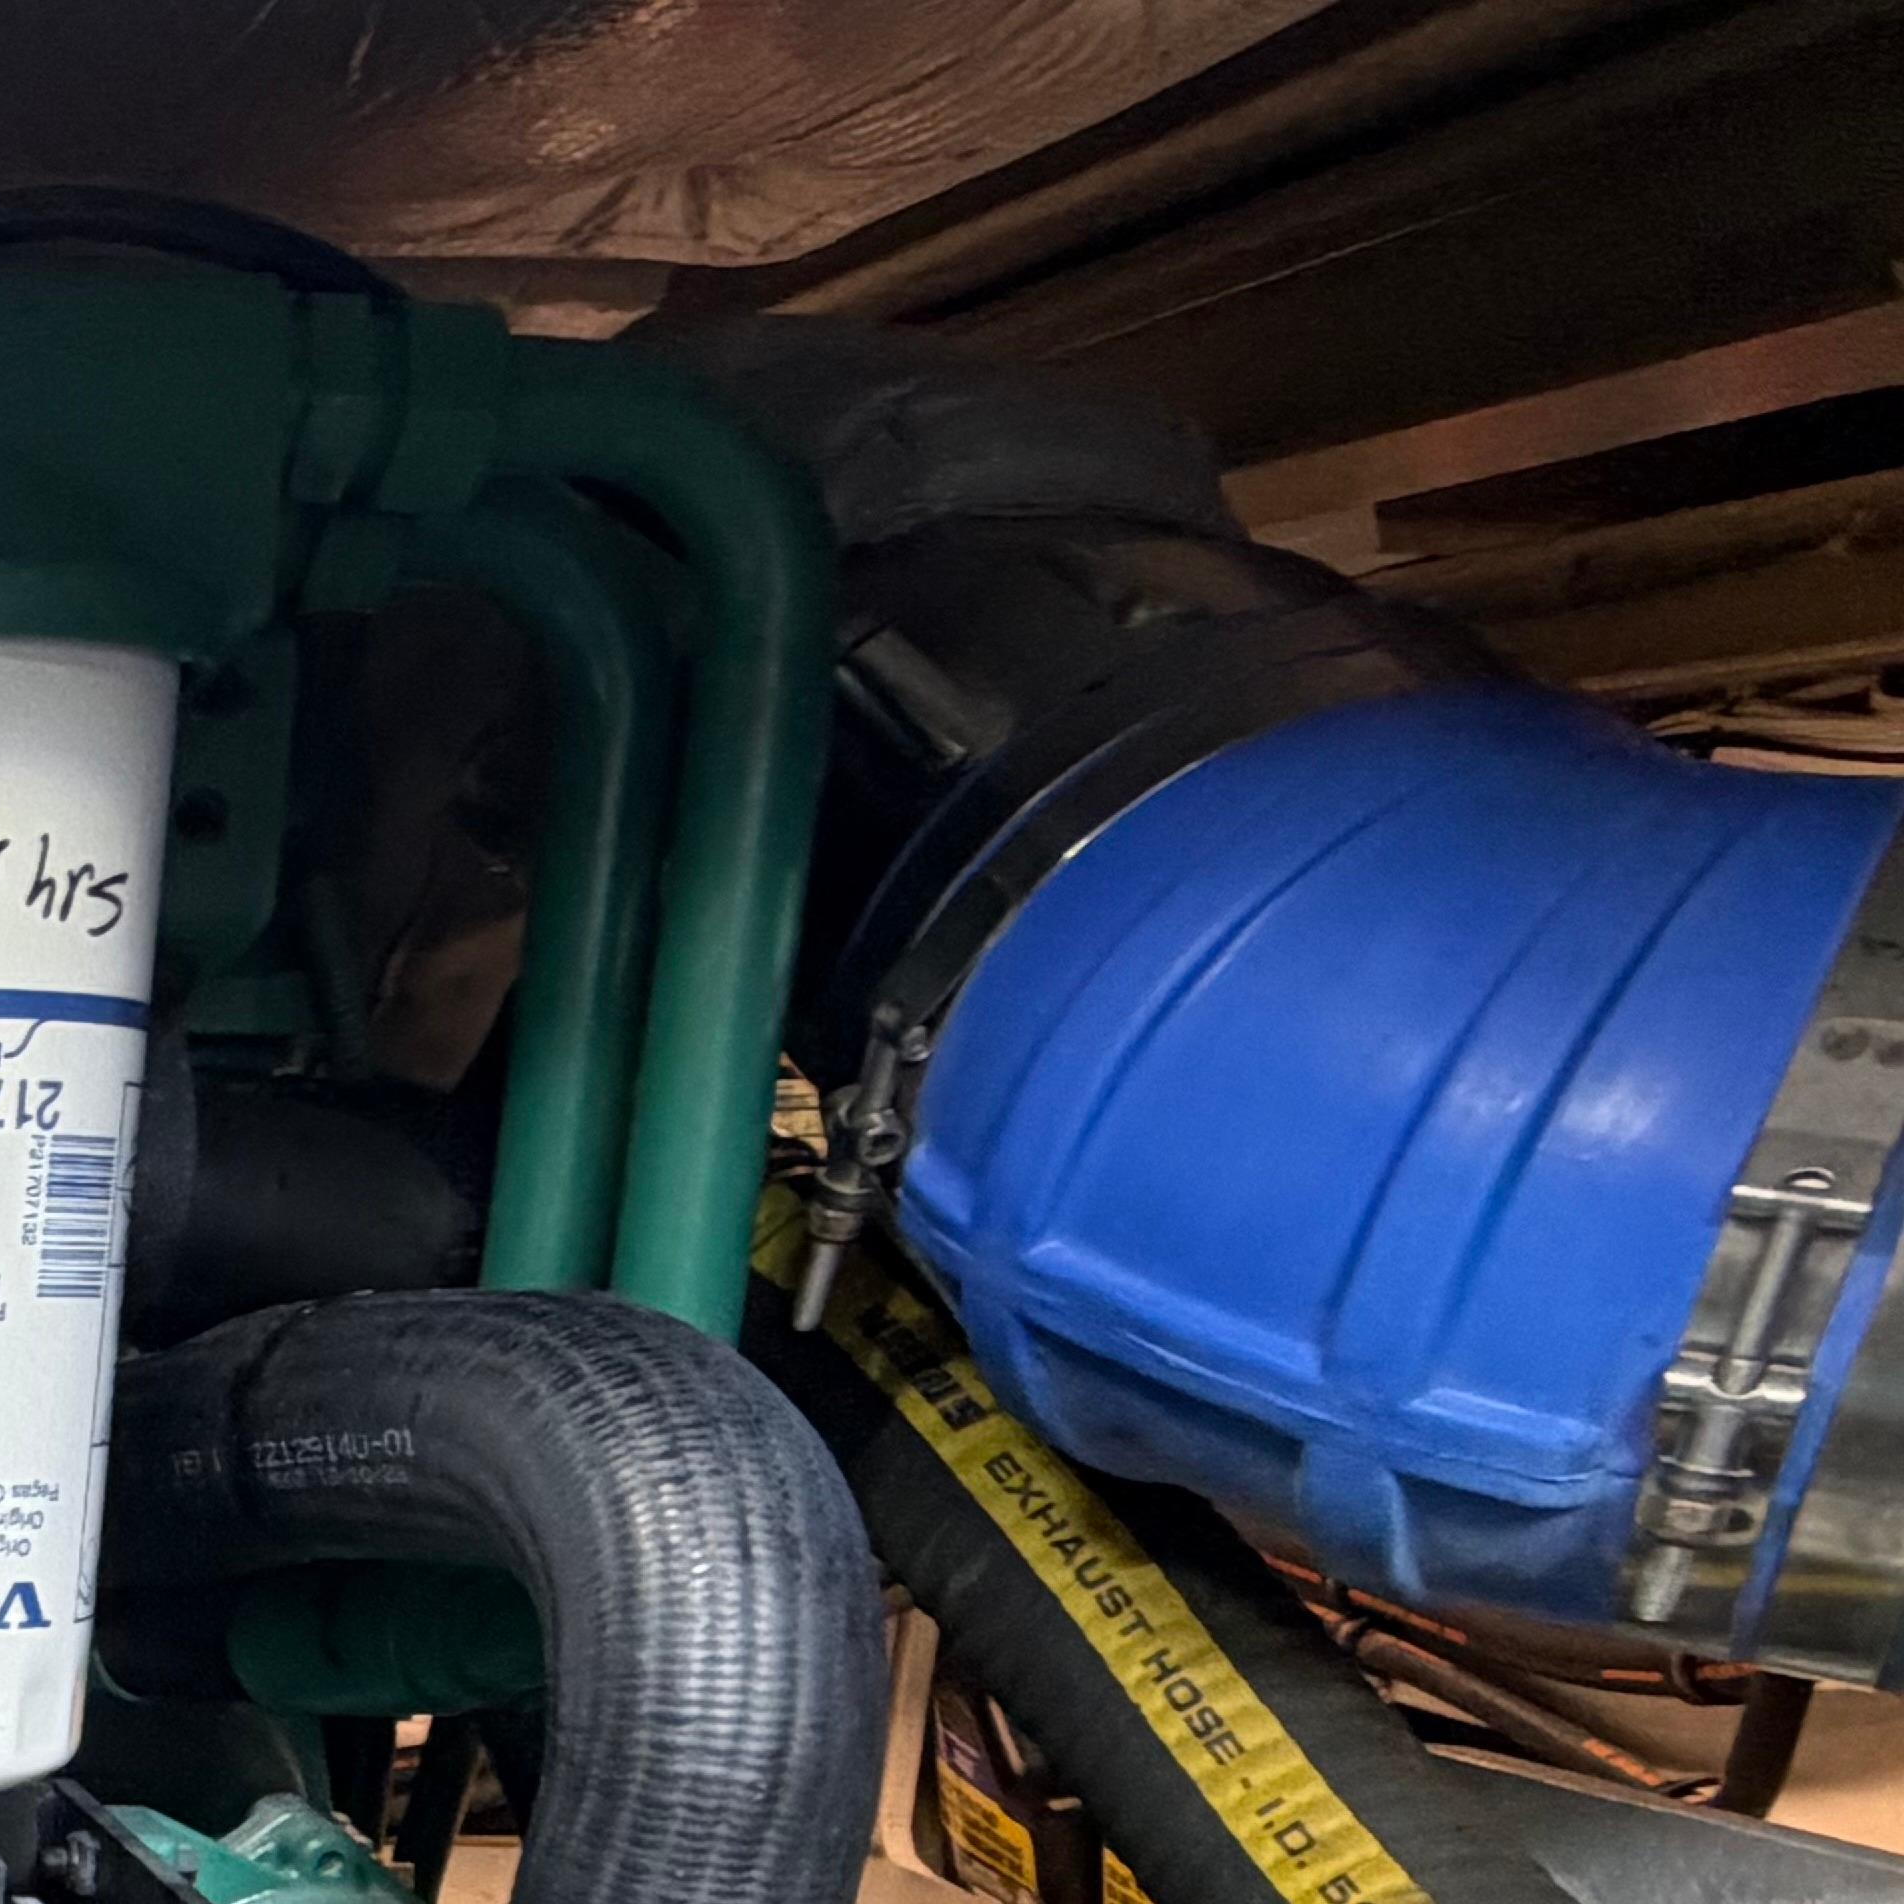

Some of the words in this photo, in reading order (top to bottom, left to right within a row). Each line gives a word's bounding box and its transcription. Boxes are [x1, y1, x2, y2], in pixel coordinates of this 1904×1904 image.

[25, 832, 130, 938] hrs
[983, 1450, 1152, 1640] EXHAUST
[1141, 1648, 1244, 1767] HOSE
